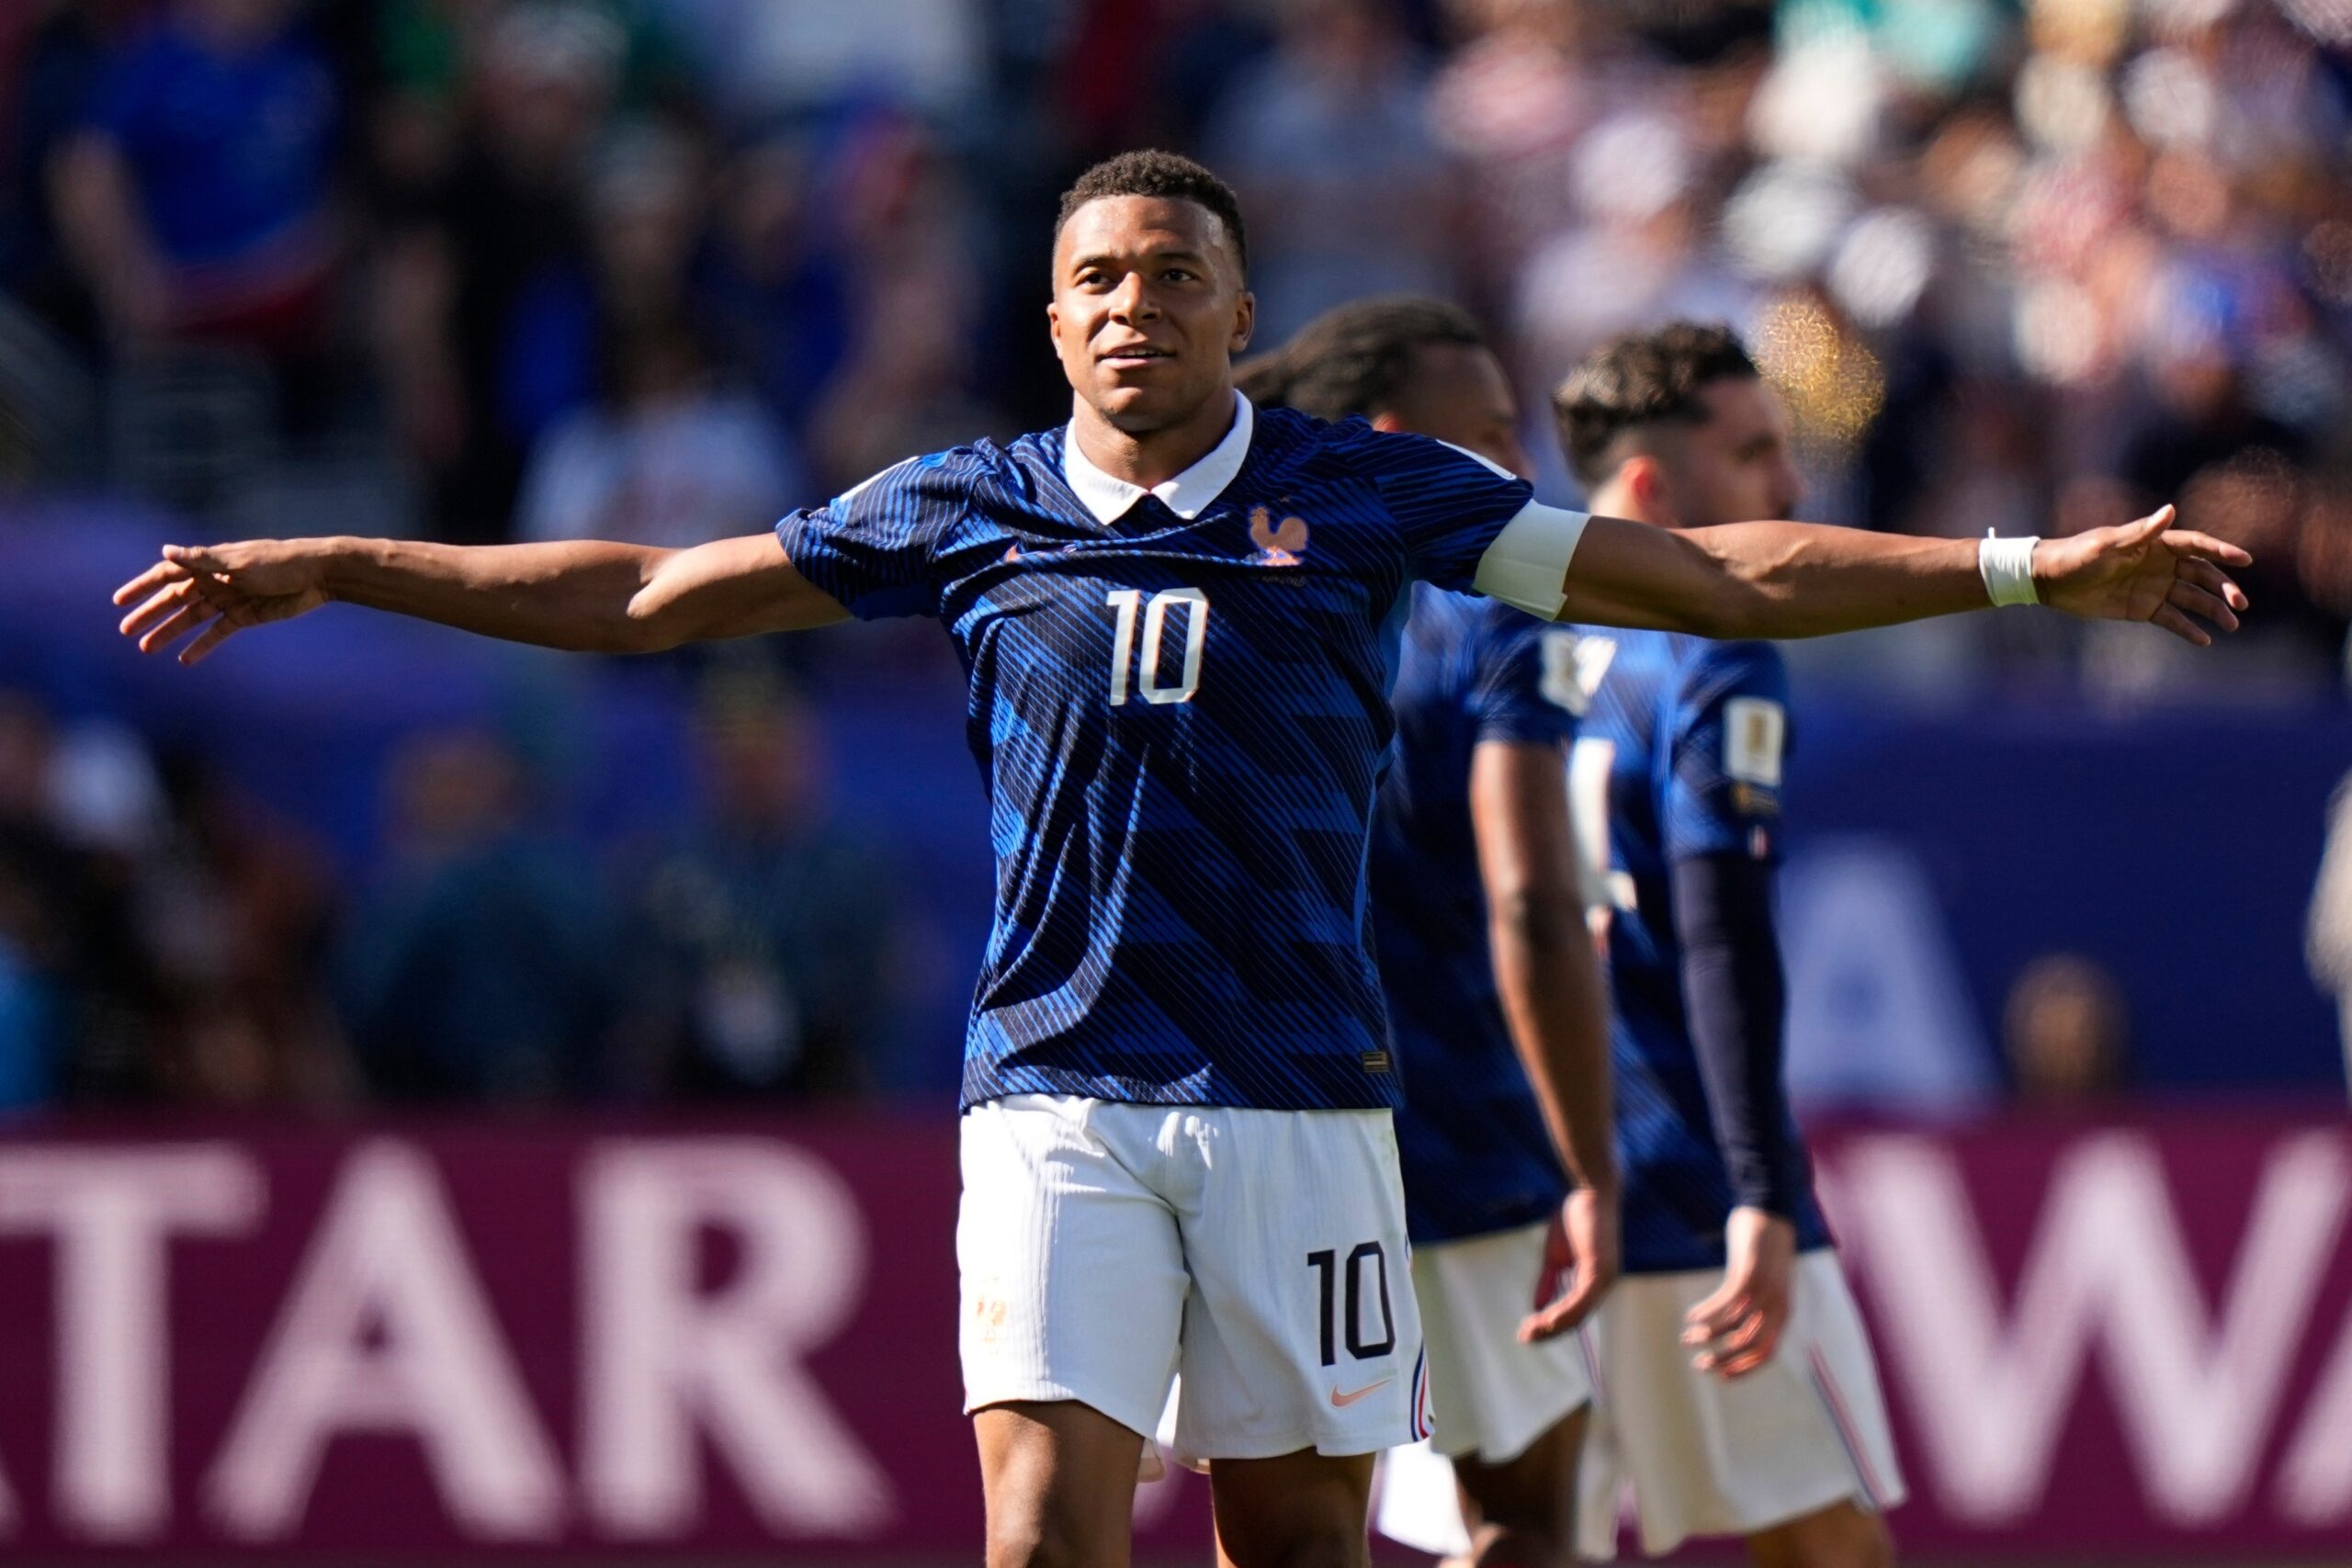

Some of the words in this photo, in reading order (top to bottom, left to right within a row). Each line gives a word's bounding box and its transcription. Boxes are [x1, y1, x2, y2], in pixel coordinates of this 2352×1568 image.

[1106, 587, 1209, 705] 10
[0, 1137, 891, 1539] TAR
[1828, 1134, 2352, 1525] W
[1307, 1241, 1396, 1366] 10
